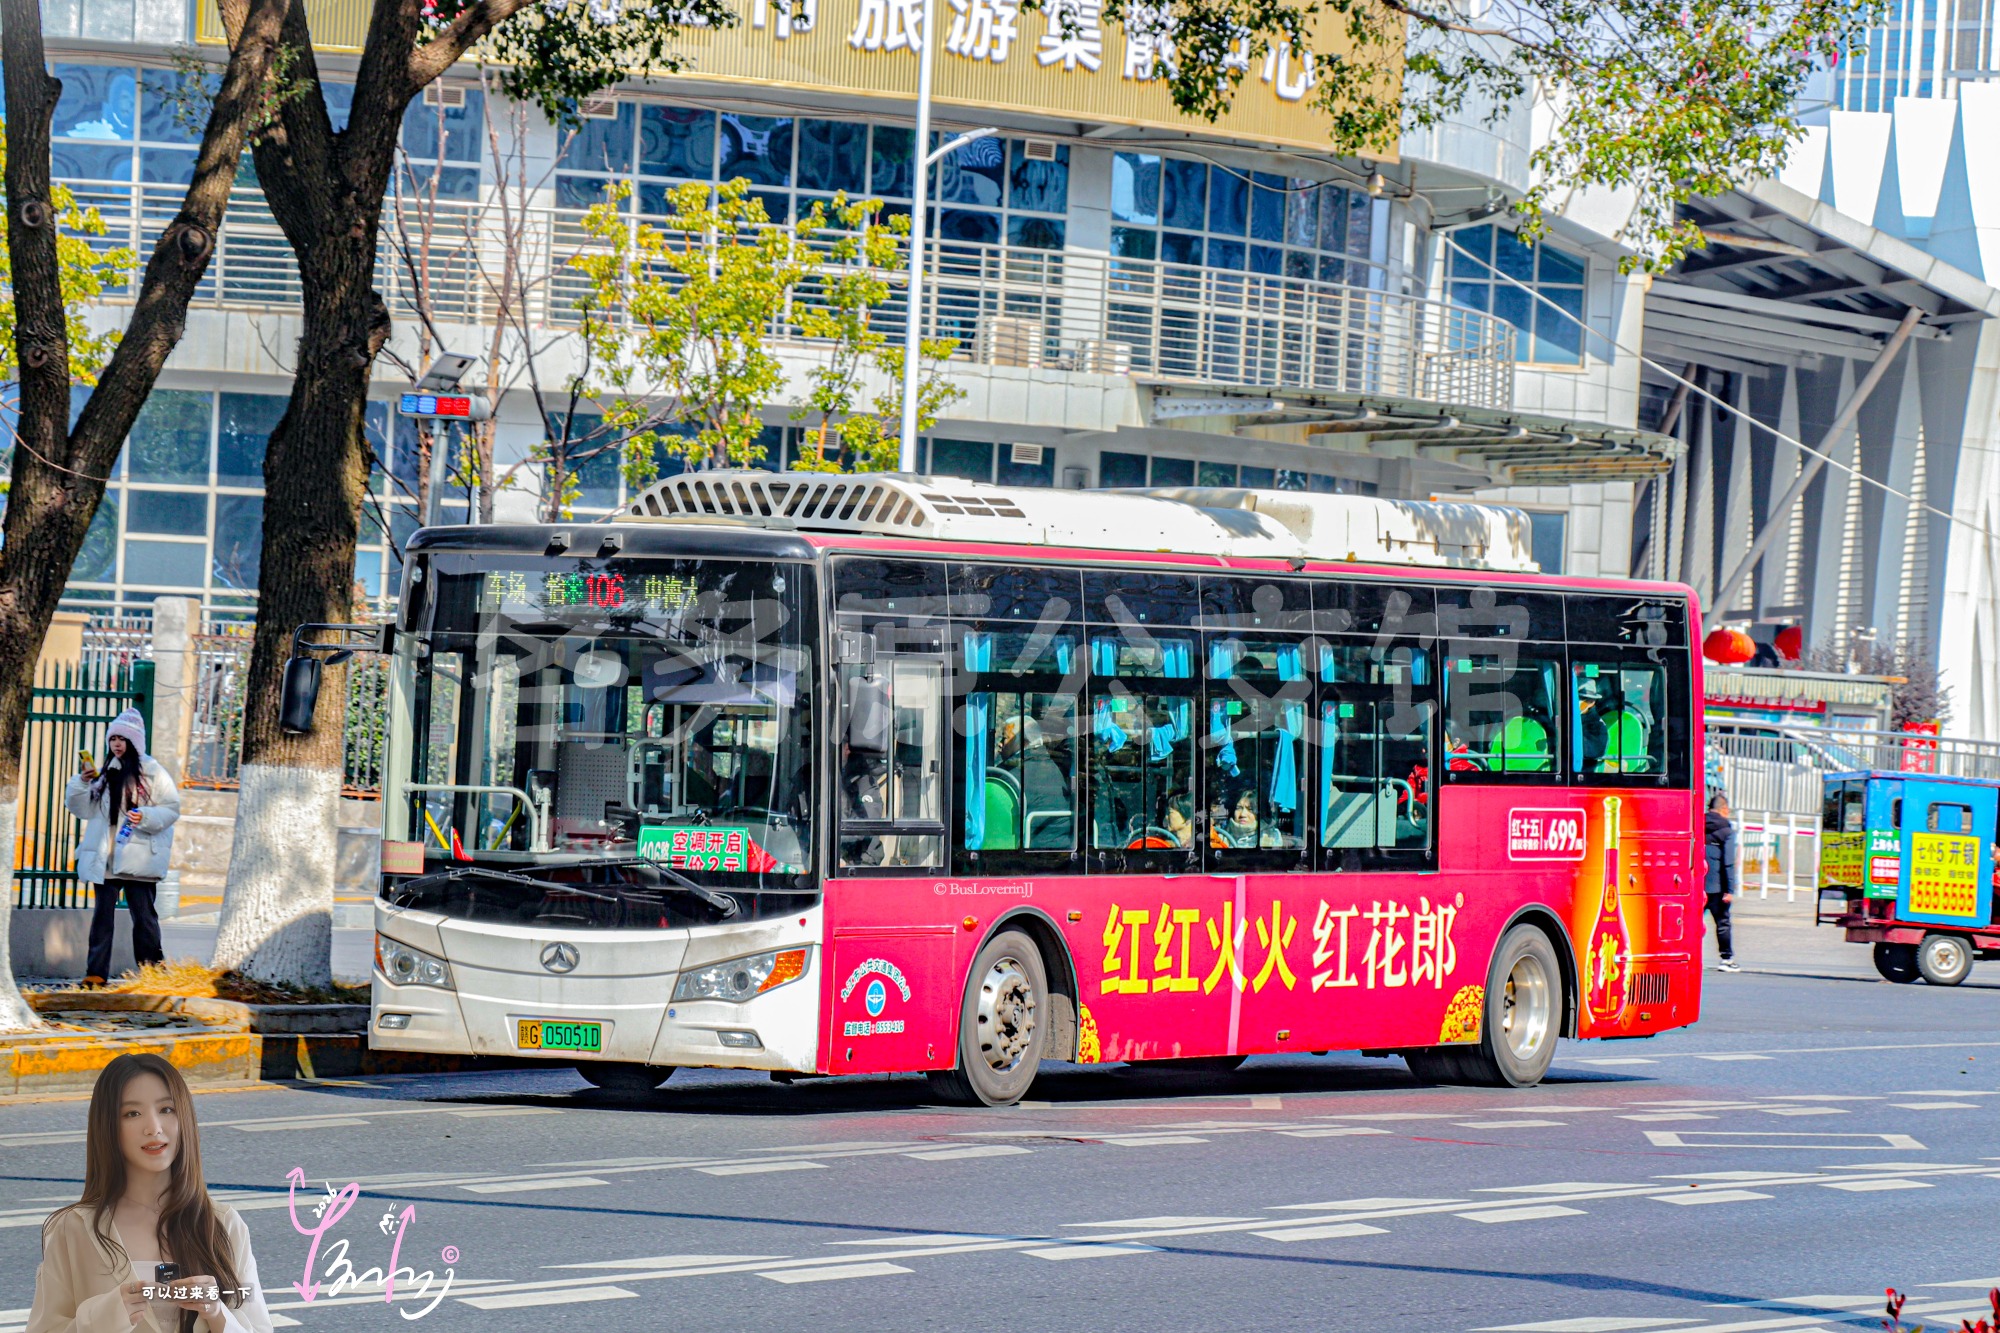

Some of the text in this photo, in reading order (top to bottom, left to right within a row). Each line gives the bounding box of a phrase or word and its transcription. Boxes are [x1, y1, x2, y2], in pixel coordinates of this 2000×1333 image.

[586, 573, 624, 608] 106
[1511, 818, 1540, 837] 红十五
[672, 831, 742, 854] 空调开启
[1101, 897, 1457, 995] 红红火火 红花郎
